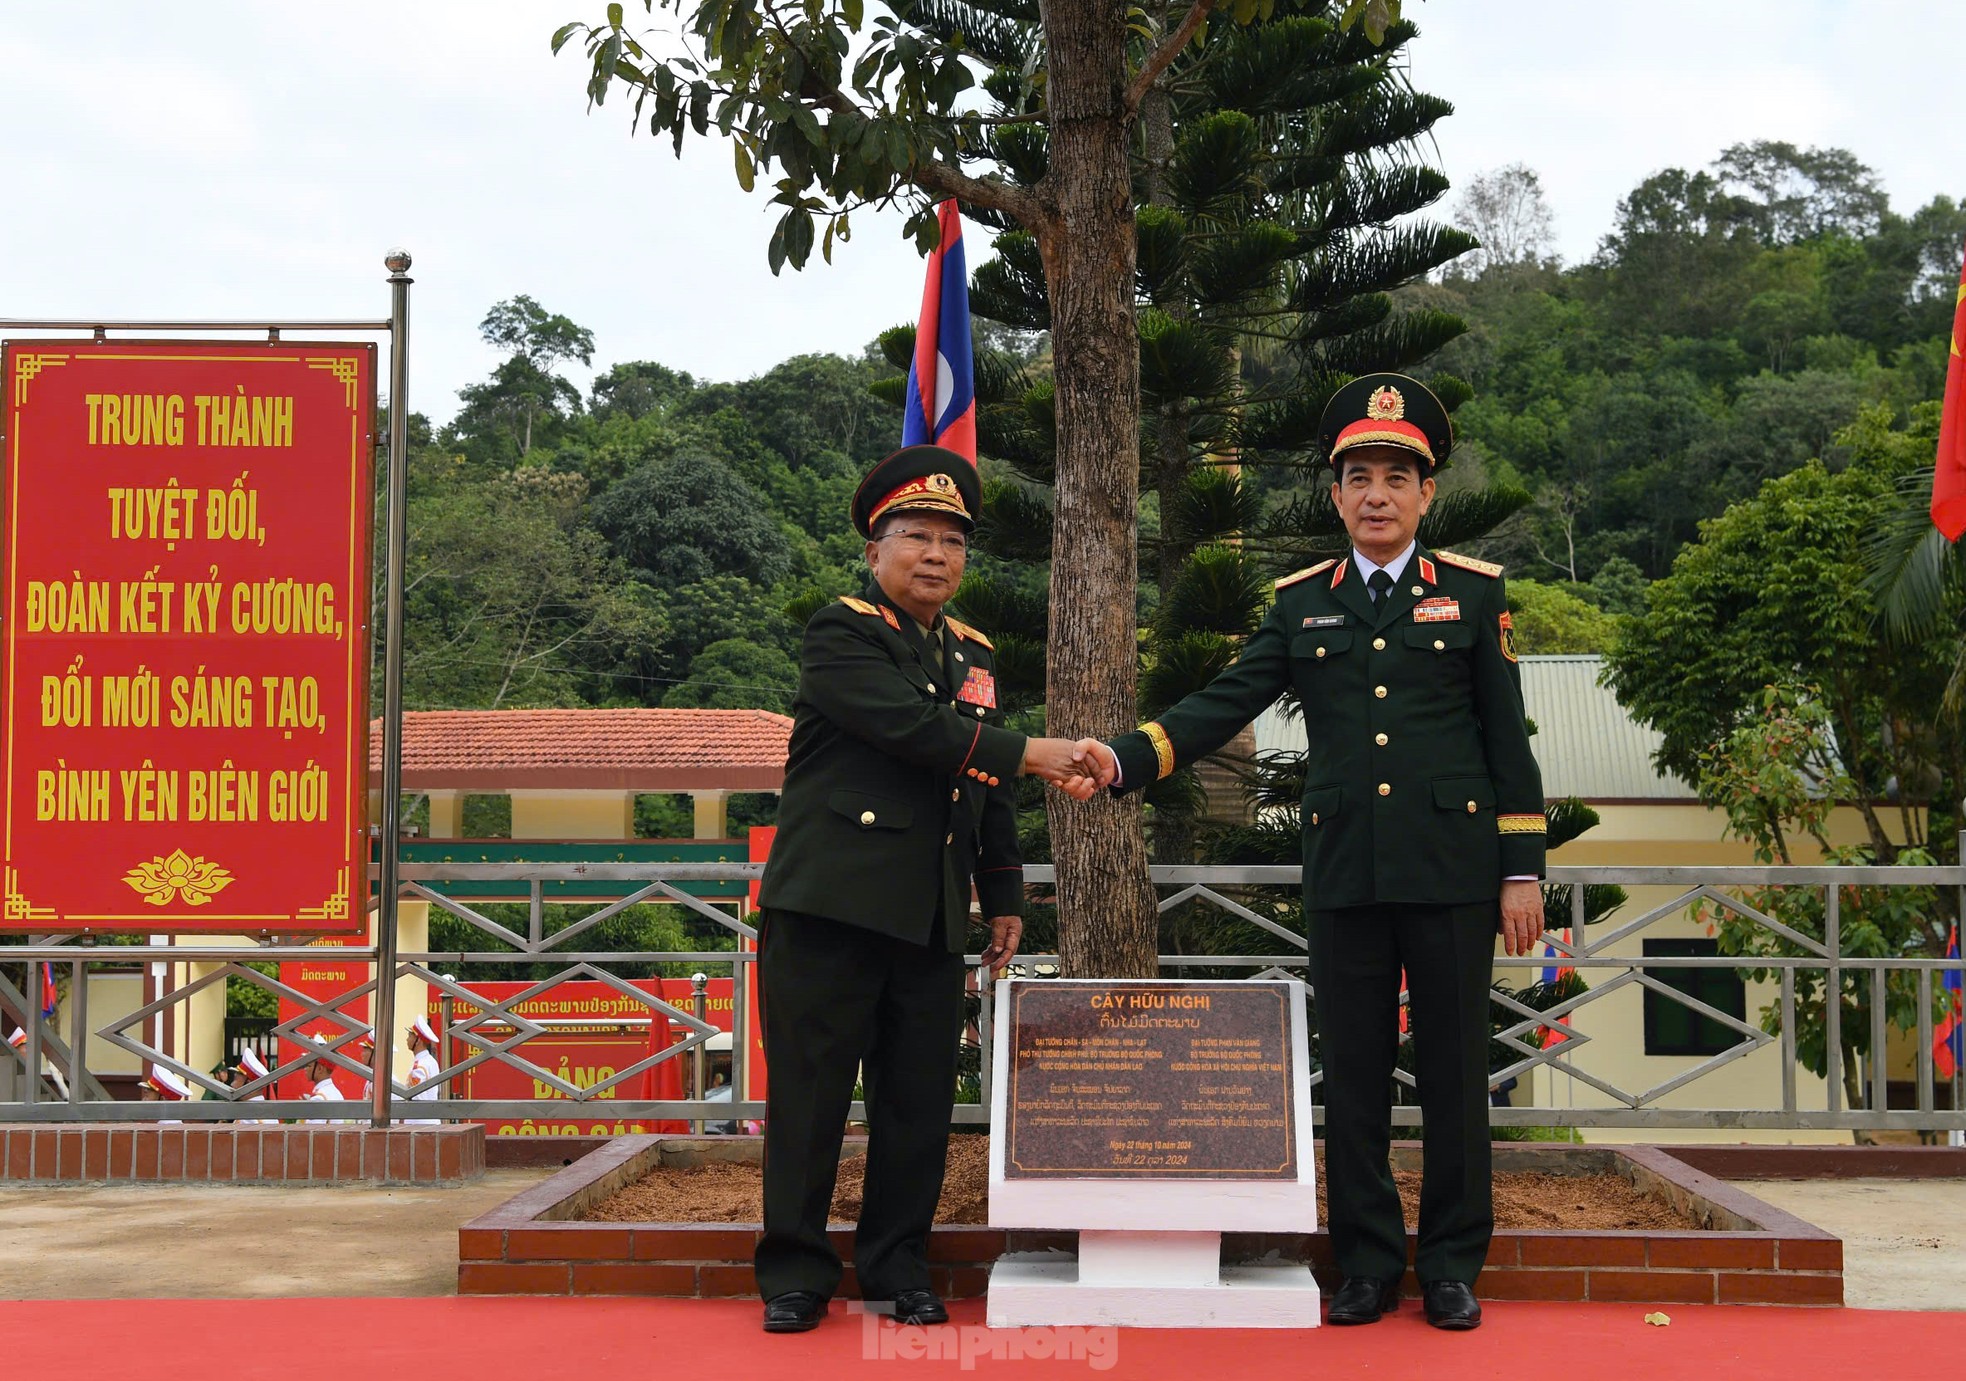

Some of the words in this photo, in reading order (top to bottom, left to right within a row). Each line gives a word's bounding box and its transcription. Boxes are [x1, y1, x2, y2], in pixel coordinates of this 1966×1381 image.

[86, 394, 184, 446] TRUNG
[195, 385, 293, 447] THÀNH
[108, 478, 198, 551] TUYỆT
[207, 471, 266, 547] ĐỐI,
[26, 571, 109, 633] ĐOÀN
[120, 566, 174, 633] KẾT
[184, 565, 222, 633] KỶ
[232, 578, 343, 641] CƯƠNG,
[41, 655, 91, 728] ĐỔI
[102, 664, 159, 728] MỚI
[170, 666, 252, 728] SÁNG
[262, 676, 326, 740] TẠO,
[36, 759, 109, 822] BÌNH
[121, 760, 178, 822] YÊN
[189, 760, 258, 822] BIÊN
[269, 760, 328, 822] GIỚI
[1091, 993, 1124, 1009] CÂY
[1131, 993, 1164, 1009] HỮU
[1170, 995, 1211, 1012] NGHỊ
[533, 1055, 616, 1099] ĐẢNG
[1134, 1155, 1146, 1164] 22
[1165, 1155, 1188, 1164] 2024
